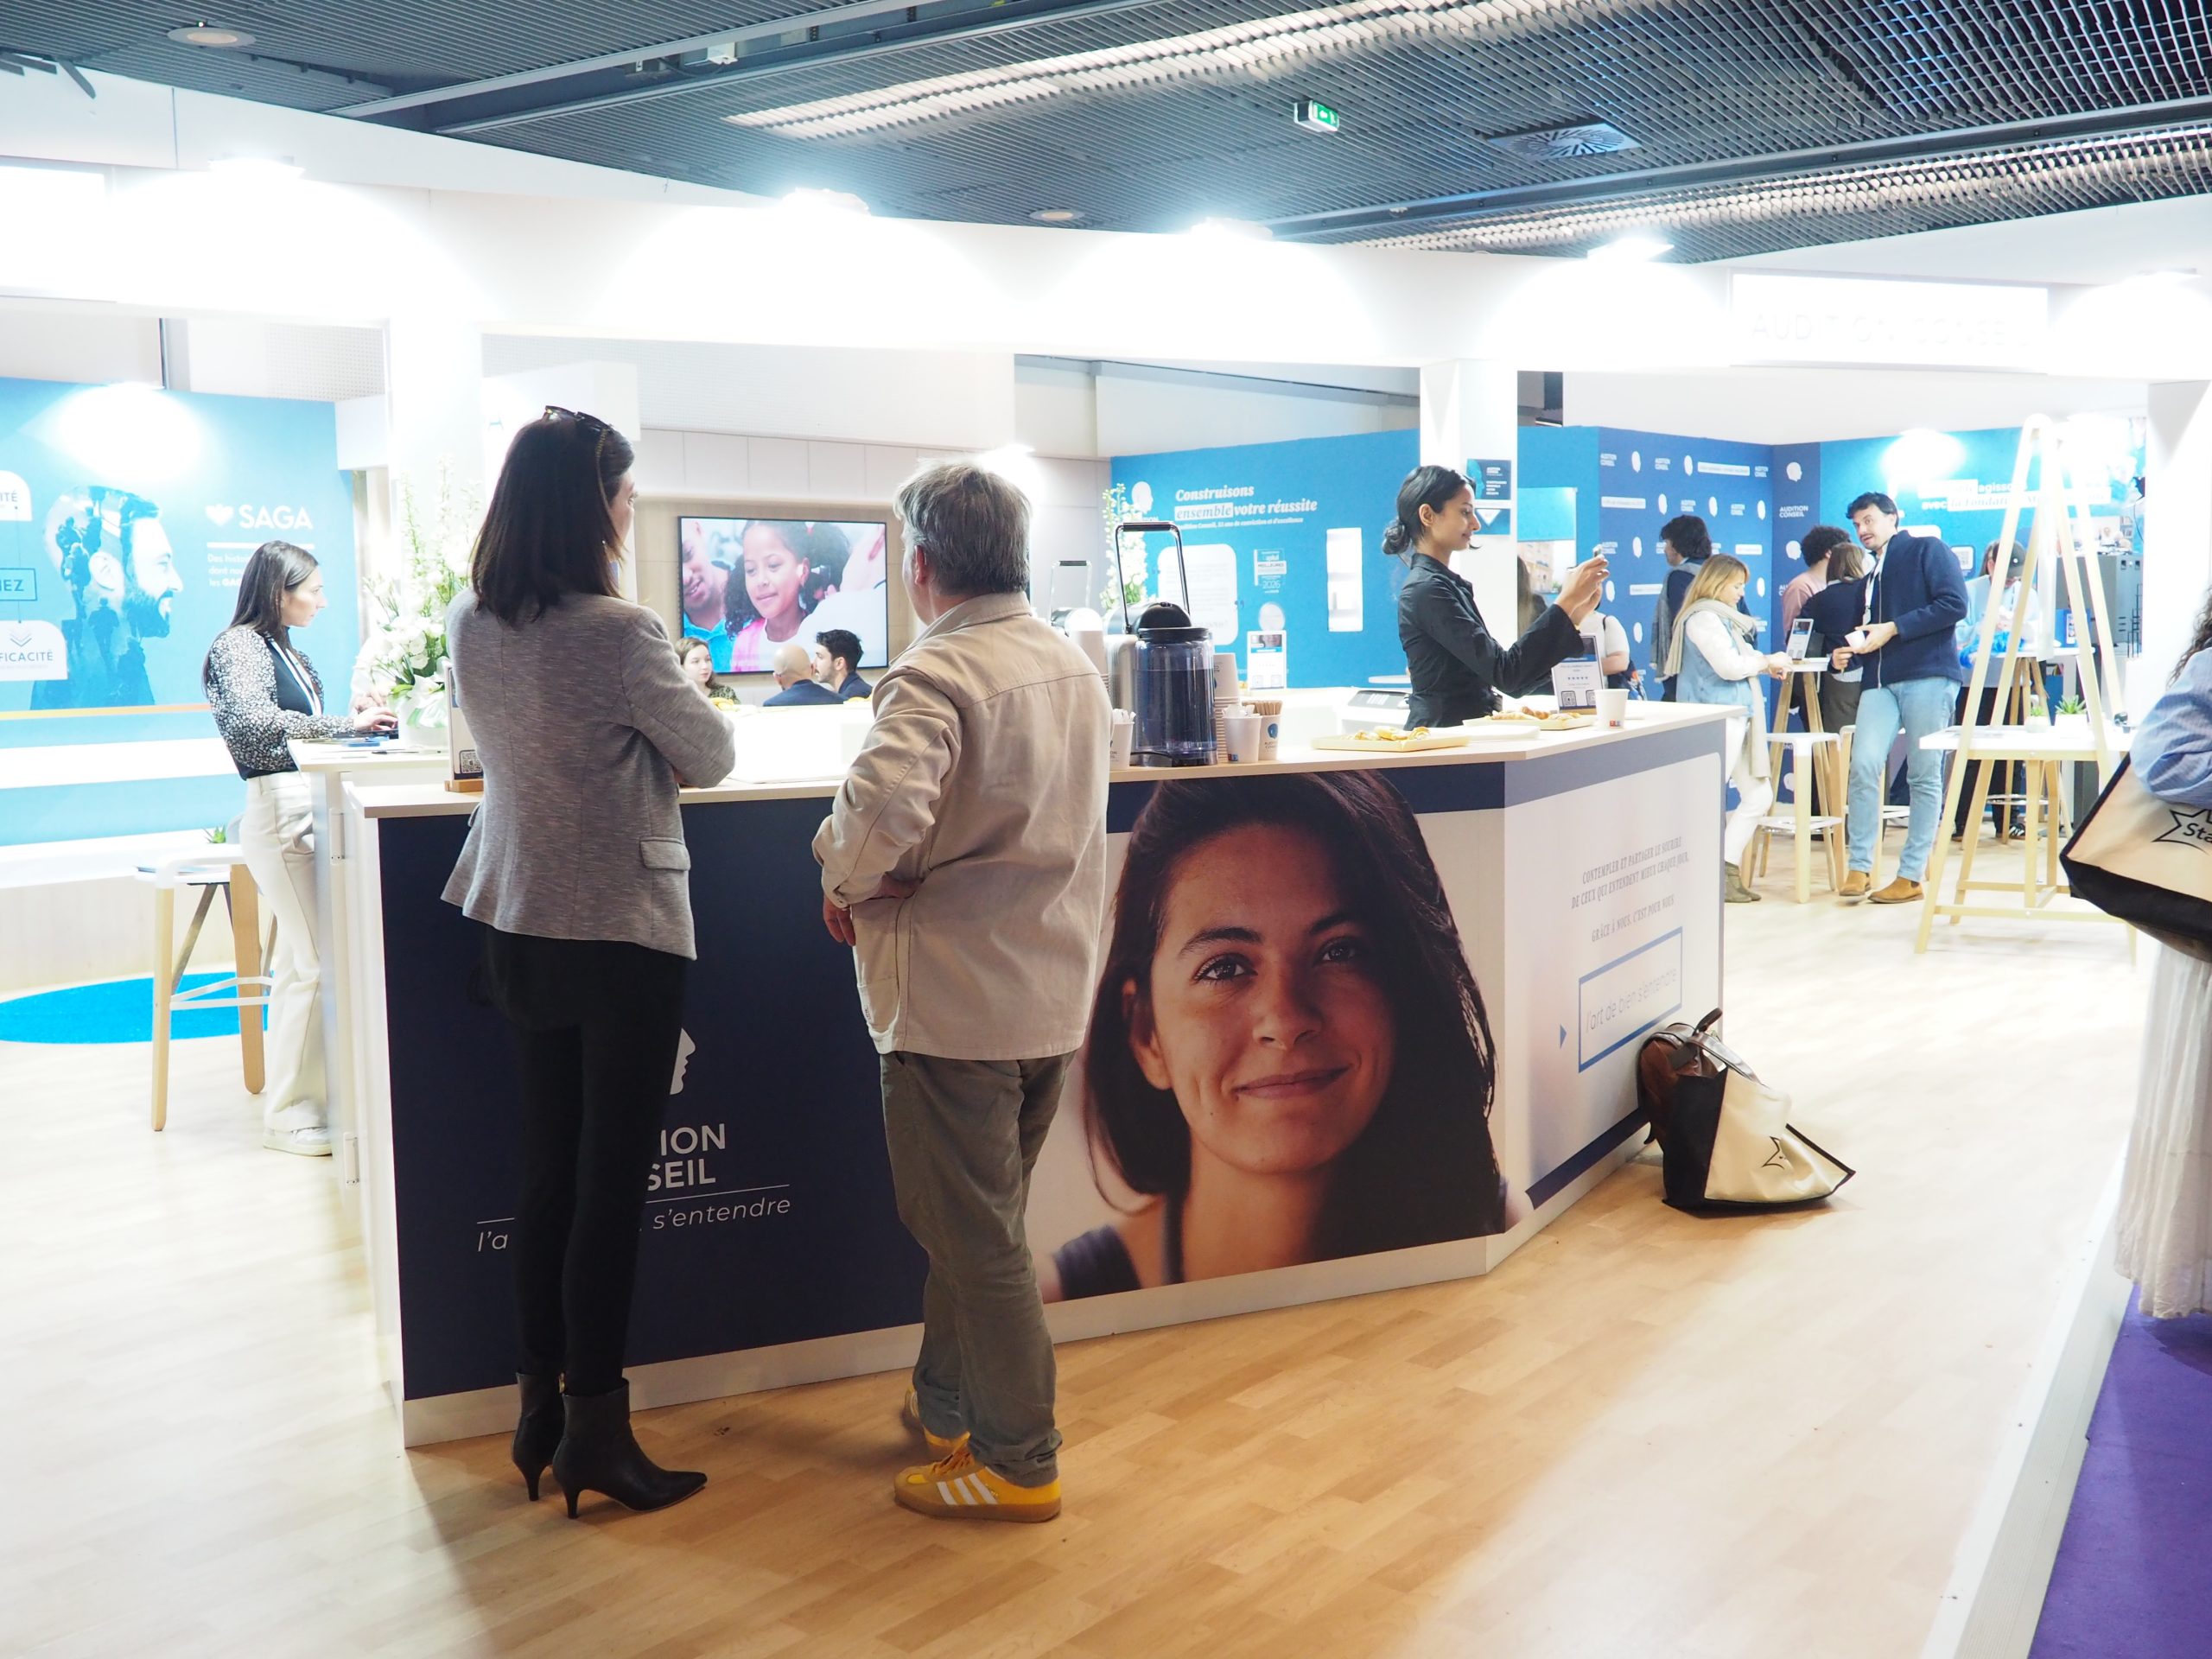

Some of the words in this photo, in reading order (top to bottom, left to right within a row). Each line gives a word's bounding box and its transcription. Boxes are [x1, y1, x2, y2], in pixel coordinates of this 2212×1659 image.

[1176, 485, 1254, 501] Construisons
[238, 504, 314, 530] SAGA
[1177, 504, 1231, 518] ensemble
[1234, 504, 1266, 516] votre
[1268, 498, 1318, 514] réussite
[1583, 860, 1618, 885] CONTEMPLER
[1620, 855, 1627, 870] ET
[1629, 847, 1654, 867] PARTAGER
[1572, 895, 1580, 909] DE
[1581, 887, 1596, 905] CEUX
[1598, 884, 1607, 902] QUI
[1609, 871, 1640, 893] ENTENDENT
[1641, 865, 1656, 880] MIEUX
[1592, 921, 1610, 942] GRÂCE
[1605, 1000, 1616, 1020] de
[652, 1196, 791, 1230] s'entendre
